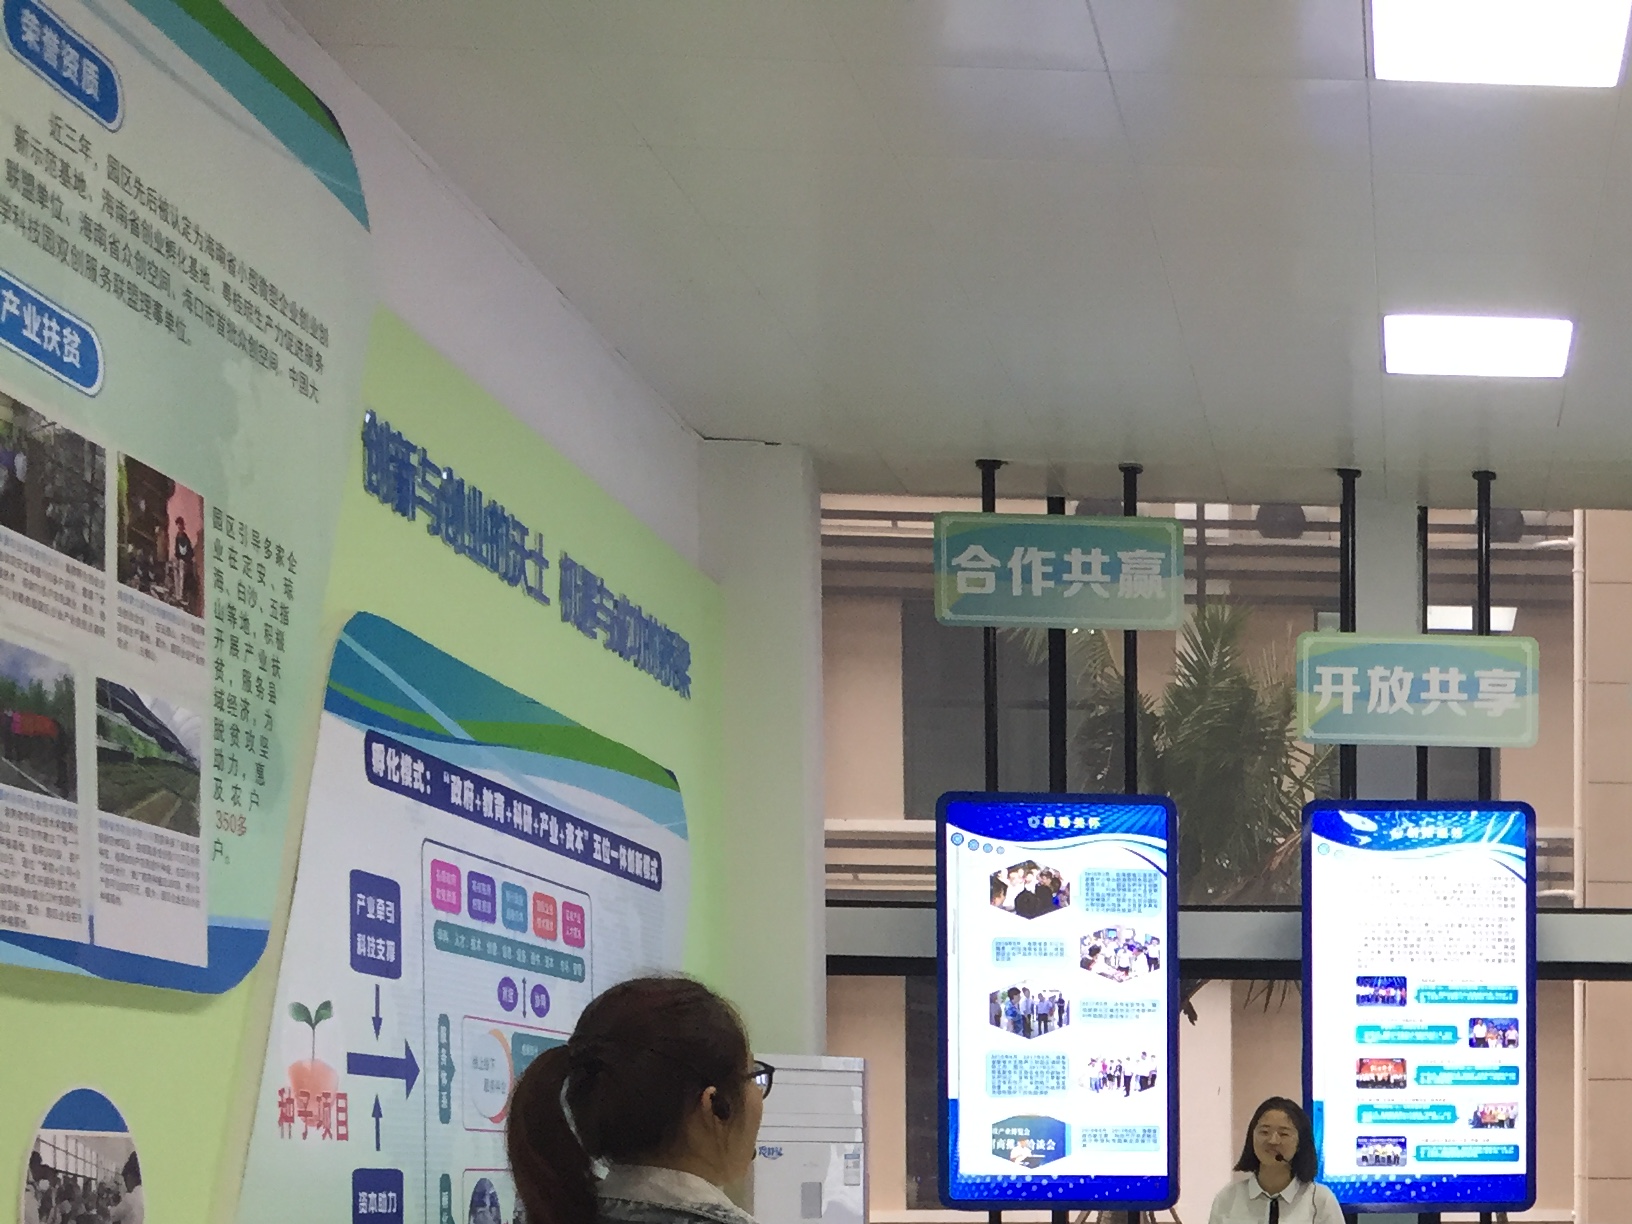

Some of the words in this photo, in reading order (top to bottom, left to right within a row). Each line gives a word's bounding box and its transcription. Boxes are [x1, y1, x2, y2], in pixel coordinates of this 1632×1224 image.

[1, 288, 82, 369] 产业扶贫
[951, 544, 1168, 600] 合作共赢
[213, 627, 281, 679] 开展产业扶
[1314, 664, 1523, 718] 开放共享
[214, 716, 269, 759] 脱贫攻坚
[213, 776, 259, 813] 及农户
[215, 809, 247, 837] 350多
[212, 837, 229, 864] 户。
[357, 891, 396, 925] 产业牵引
[356, 932, 396, 964] 科技支撑
[277, 1087, 349, 1142] 种子项目
[358, 1190, 397, 1216] 资本助力
